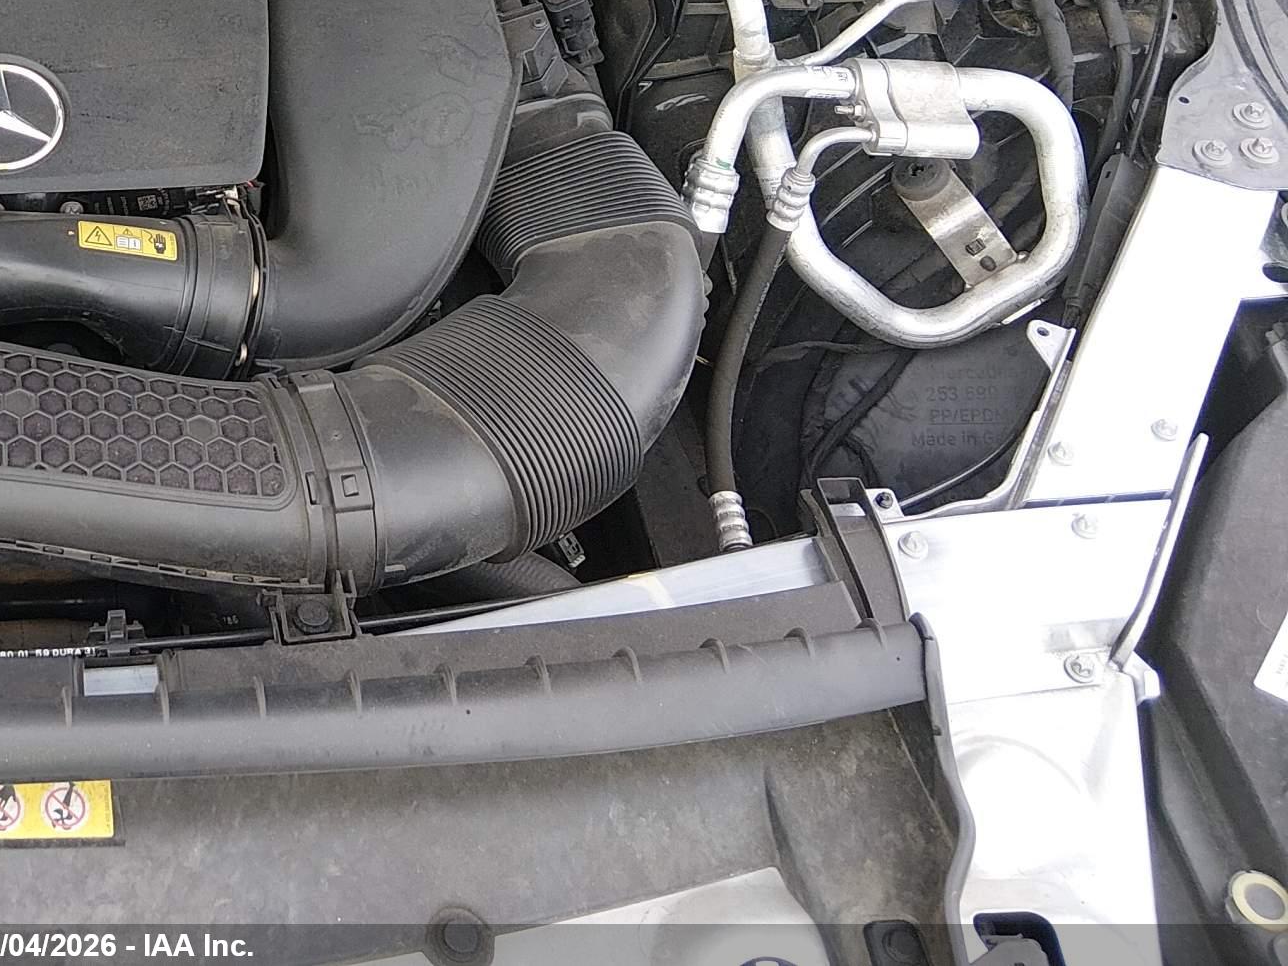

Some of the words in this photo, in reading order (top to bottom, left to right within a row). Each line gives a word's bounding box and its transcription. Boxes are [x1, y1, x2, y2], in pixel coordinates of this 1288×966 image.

[924, 385, 959, 402] 253
[911, 430, 957, 447] Made
[961, 430, 978, 446] in
